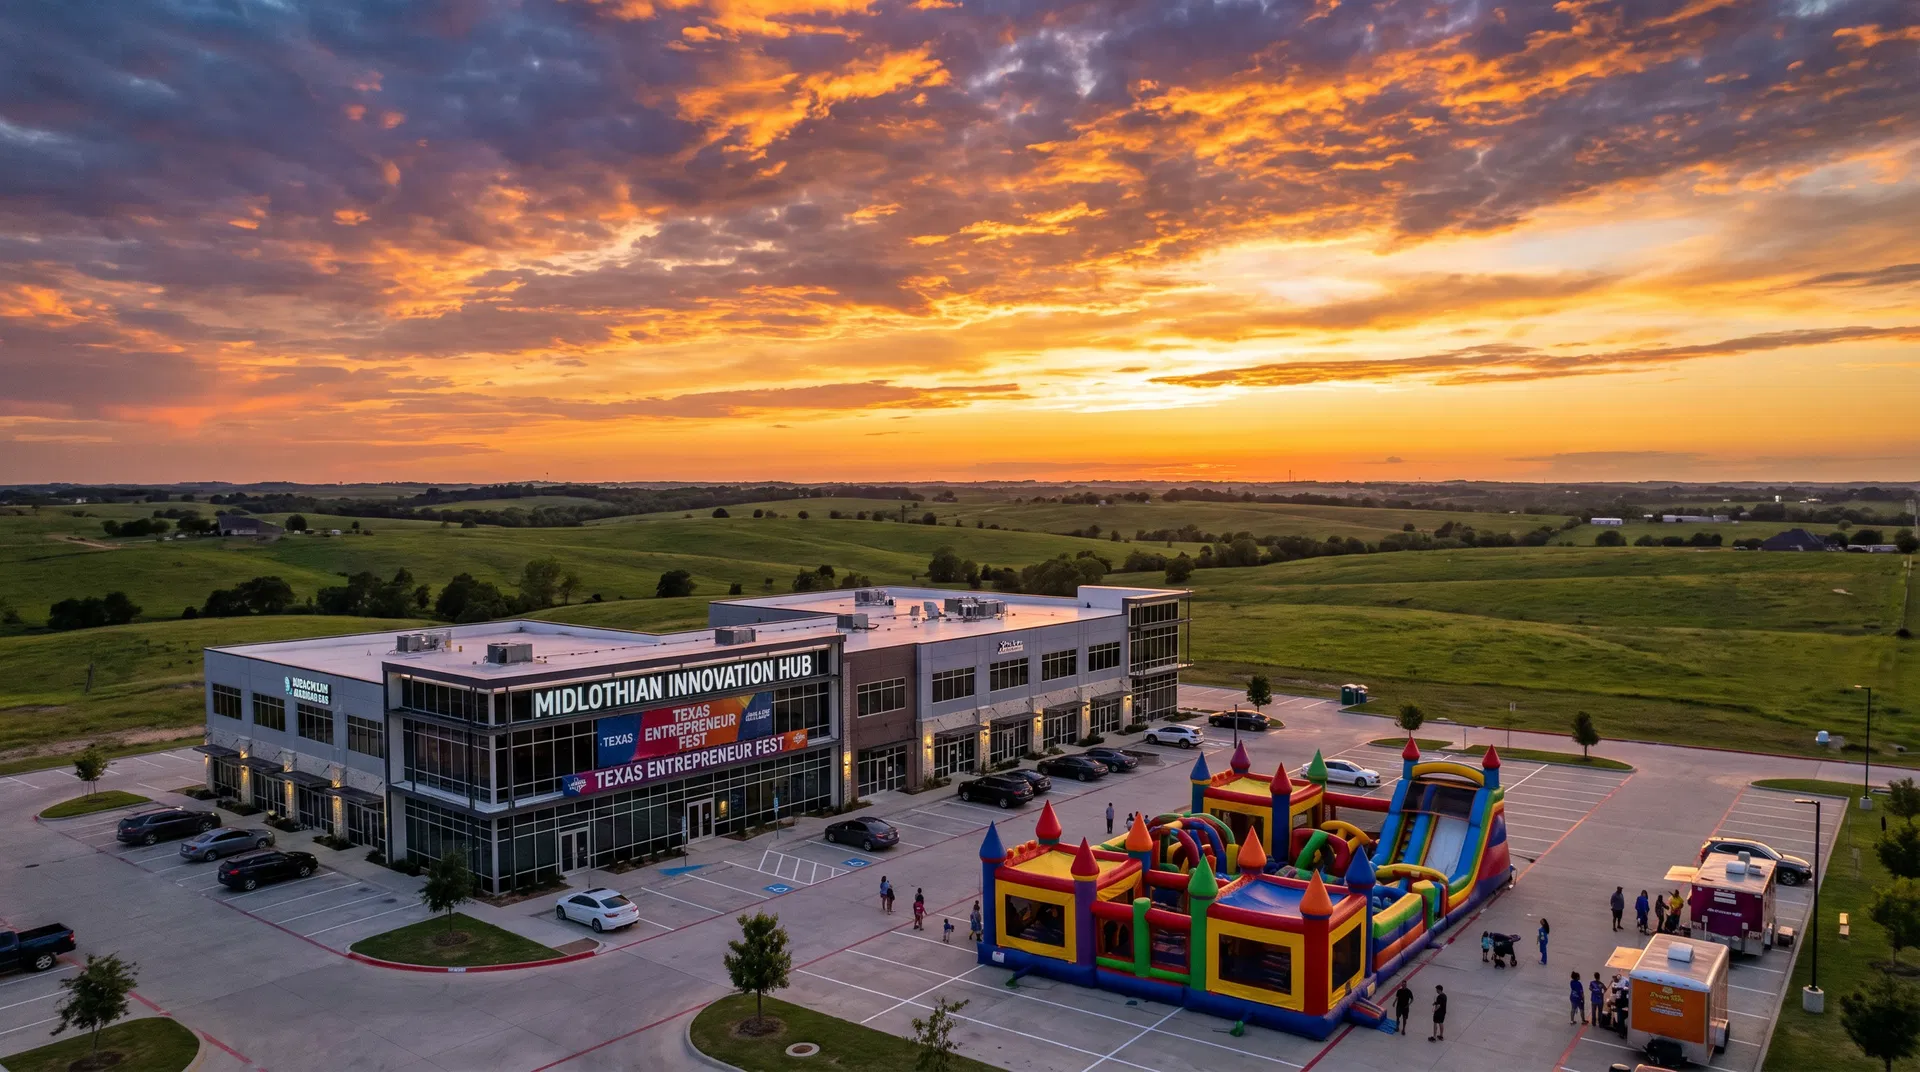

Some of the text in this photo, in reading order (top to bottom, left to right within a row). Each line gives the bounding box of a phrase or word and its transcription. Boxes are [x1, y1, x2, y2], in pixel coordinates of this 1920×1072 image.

[535, 655, 812, 718] MIDLOTHIAN INNOVATION HUB
[673, 704, 710, 723] TEXAS
[645, 713, 736, 742] ENTREPRENEUR
[603, 733, 633, 748] TEXAS
[679, 732, 707, 750] FEST
[595, 765, 643, 789] TEXAS
[648, 743, 752, 779] ENTREPRENEUR
[756, 736, 784, 755] FEST
